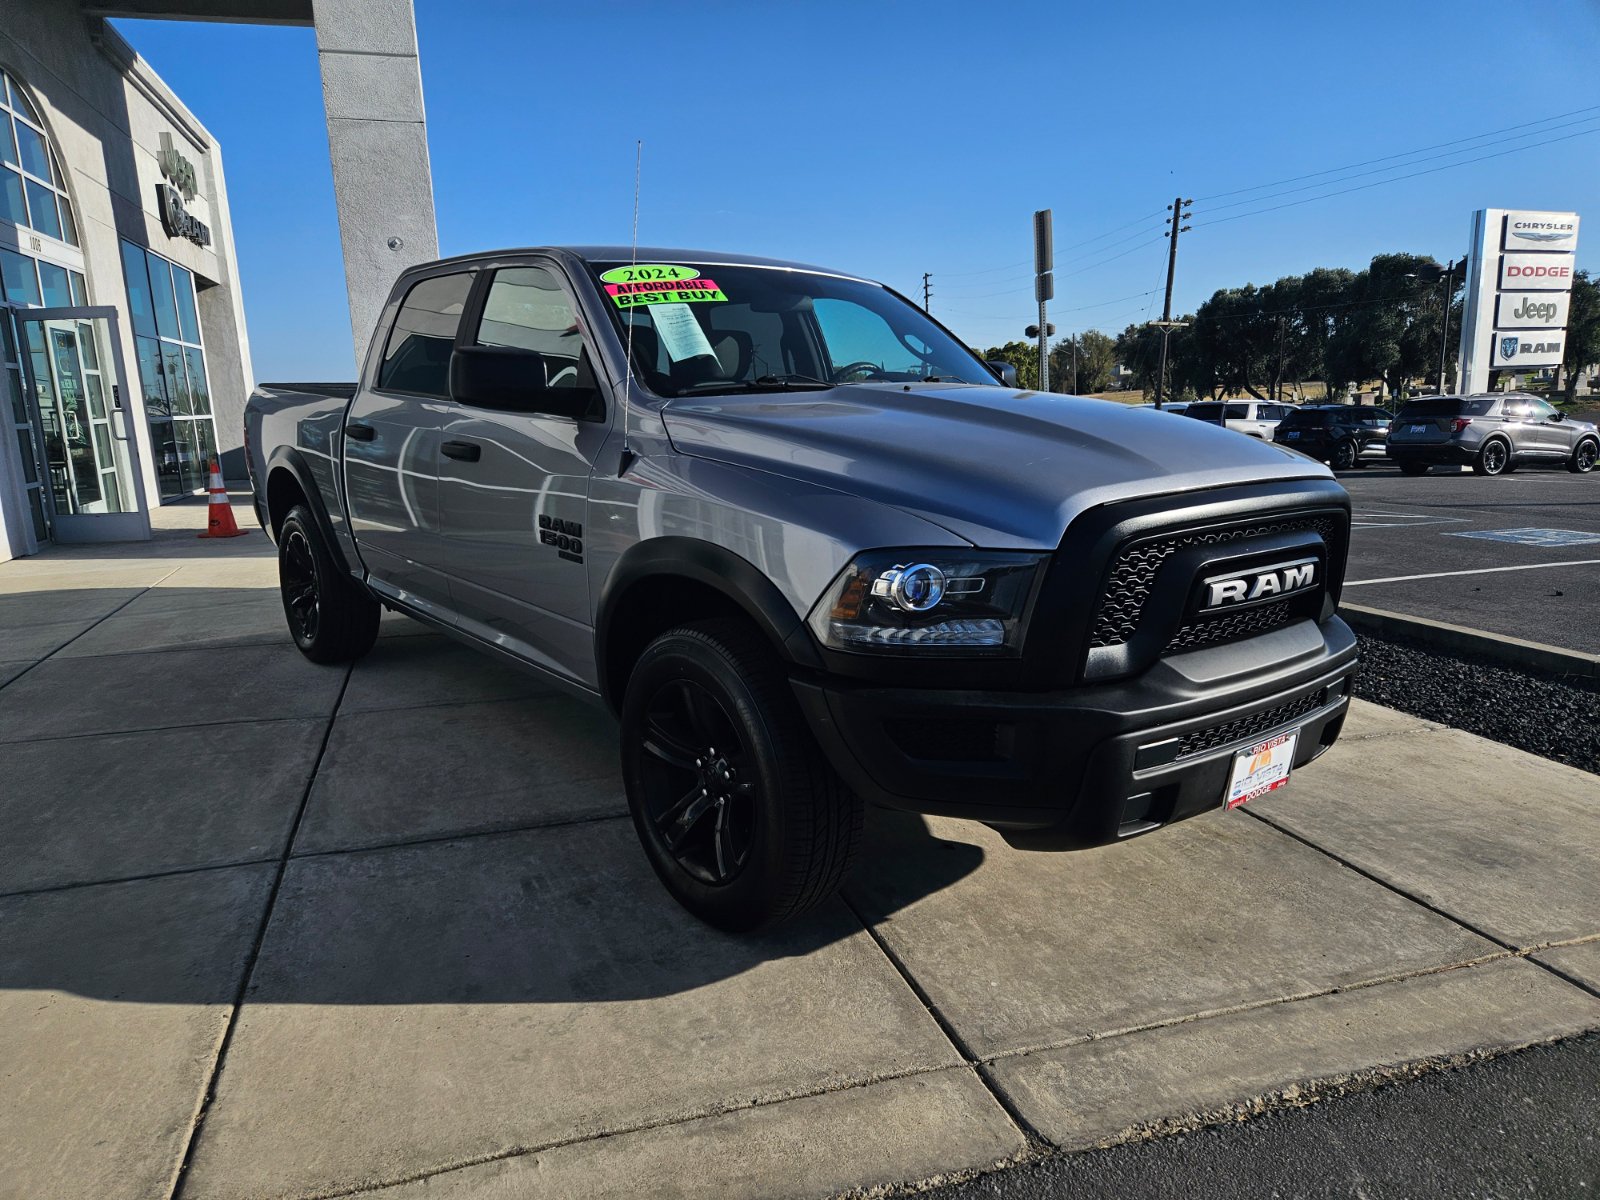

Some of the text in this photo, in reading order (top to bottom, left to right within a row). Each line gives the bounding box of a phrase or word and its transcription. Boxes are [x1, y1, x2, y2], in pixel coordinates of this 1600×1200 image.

[1514, 222, 1573, 231] CHRYSLER
[623, 267, 681, 282] 2024
[1507, 266, 1570, 277] DODGE
[617, 280, 709, 294] AFFORDABLE
[617, 290, 719, 306] BEST BUY
[1514, 297, 1557, 323] Jeep
[1519, 342, 1561, 354] RAM
[538, 514, 582, 538] RAM
[539, 530, 583, 554] 1500
[1208, 563, 1314, 606] RAM
[1253, 736, 1286, 755] RIO VISTA
[1245, 784, 1272, 801] DODGE
